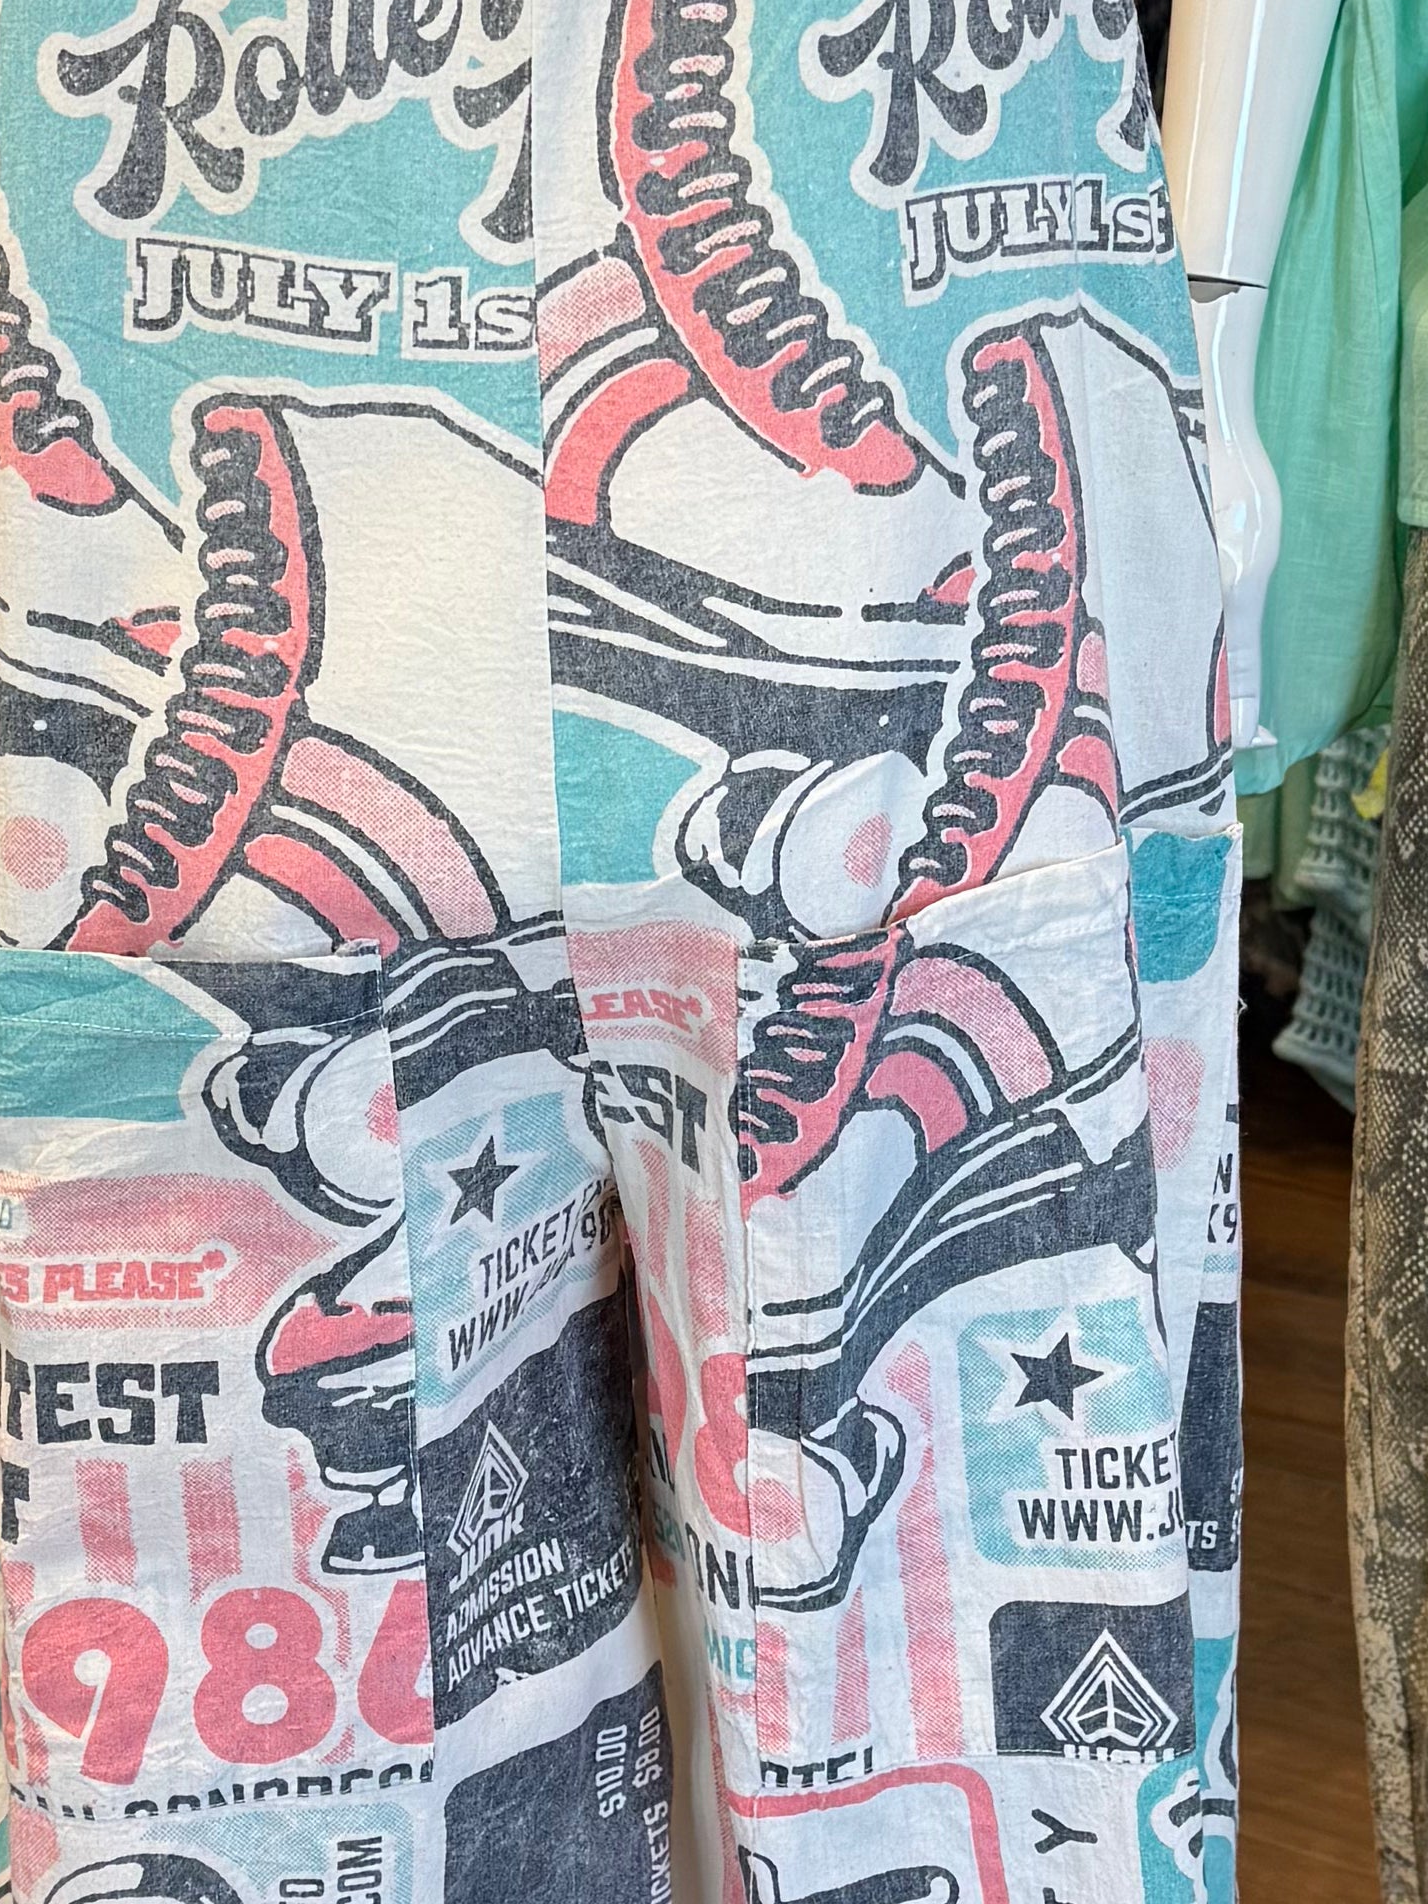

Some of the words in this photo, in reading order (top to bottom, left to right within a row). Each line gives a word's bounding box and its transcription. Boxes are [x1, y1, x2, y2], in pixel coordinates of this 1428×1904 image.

[903, 184, 1073, 294] JULY
[132, 240, 390, 346] JULY
[408, 274, 531, 354] 1s
[43, 1248, 228, 1304] PLEASE
[478, 1198, 577, 1299] TICKET
[1054, 1430, 1180, 1491] TICKE
[444, 1537, 566, 1649] ADMISSION
[448, 1502, 526, 1595] JUNK
[447, 1594, 554, 1694] ADVANCE
[595, 1723, 629, 1821] $10.00
[631, 1705, 664, 1791] $8.00
